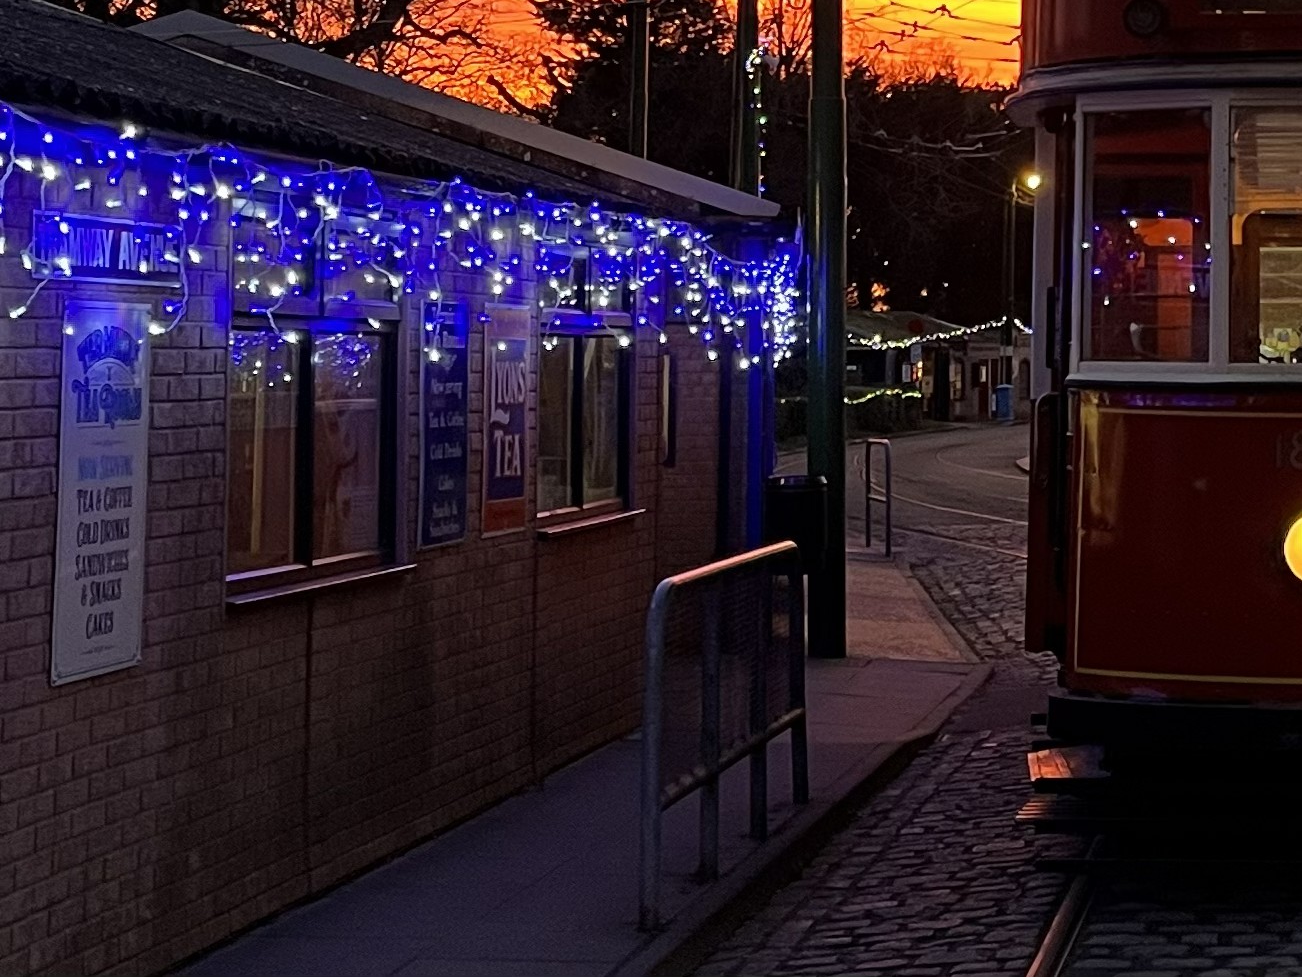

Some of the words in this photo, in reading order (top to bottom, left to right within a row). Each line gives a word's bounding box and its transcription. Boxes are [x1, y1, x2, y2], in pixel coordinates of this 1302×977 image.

[490, 346, 526, 425] LYONS
[493, 429, 522, 478] TEA
[78, 521, 99, 547] COLD
[101, 517, 130, 545] DRINKS
[90, 578, 122, 607] SNACKS
[86, 611, 114, 639] CAKES
